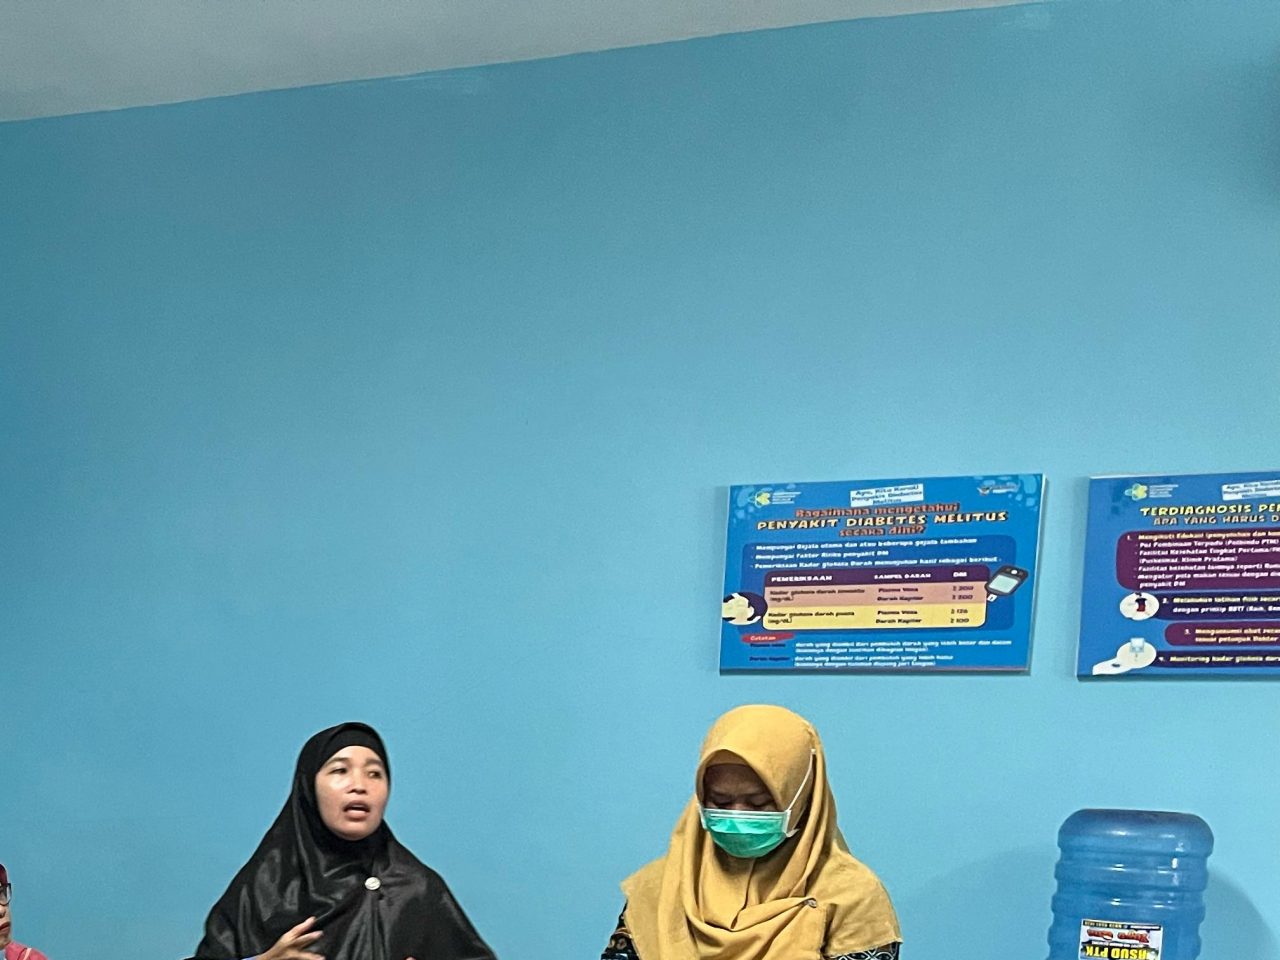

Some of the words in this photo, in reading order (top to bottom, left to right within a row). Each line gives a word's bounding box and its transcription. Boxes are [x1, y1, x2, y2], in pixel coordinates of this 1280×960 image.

[1140, 504, 1252, 516] TERDIAGNOSIS
[758, 519, 838, 530] PENYAKIT
[846, 515, 926, 527] DIABETES
[934, 512, 1007, 523] MELITUS
[1184, 516, 1216, 524] YANG
[1223, 515, 1265, 523] HARUS
[1086, 945, 1109, 958] PTK
[1111, 947, 1147, 960] RSUD
